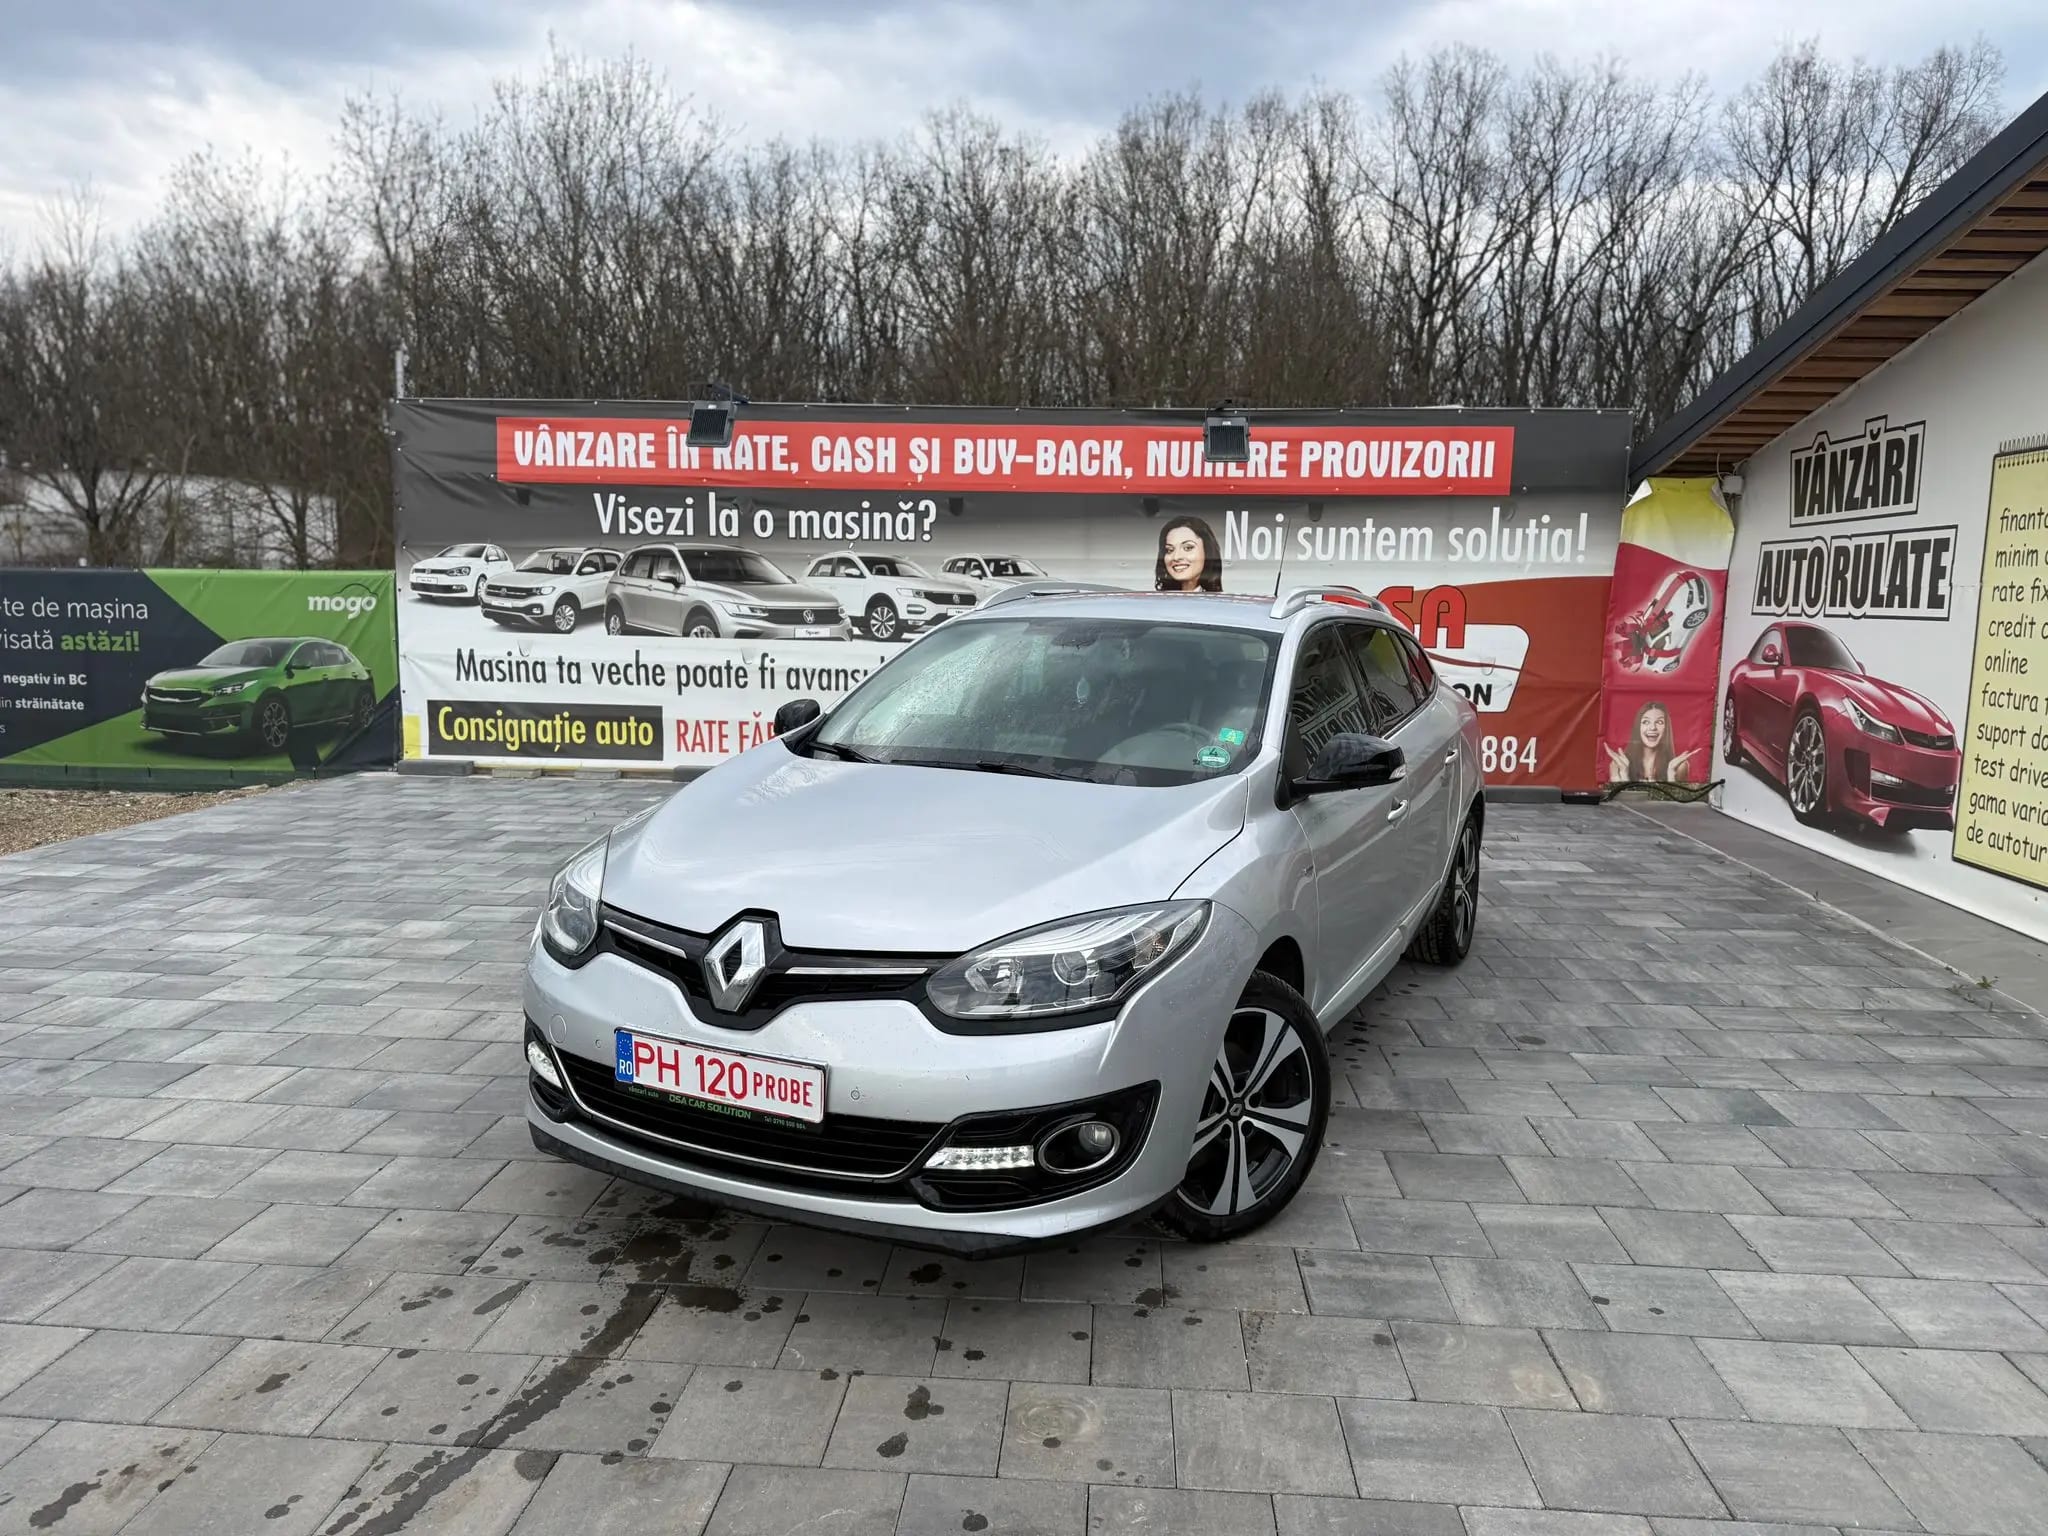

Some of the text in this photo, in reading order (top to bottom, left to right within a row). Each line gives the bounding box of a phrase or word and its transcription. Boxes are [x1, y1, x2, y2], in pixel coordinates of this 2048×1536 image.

[514, 424, 656, 468] VÂNZARE
[811, 435, 896, 473] CASH
[909, 437, 941, 483] ȘI
[1300, 440, 1496, 479] PROVIZORII
[1794, 427, 1919, 518] VÂNZĂRI
[593, 491, 938, 549] Visezi la o mașină?
[1224, 506, 1588, 575] Noi suntem soluția!
[1995, 543, 2039, 568] minim
[1756, 537, 1951, 610] AUTO RULATE
[1992, 581, 2025, 603] rate
[32, 596, 59, 617] de
[67, 598, 149, 624] mașina
[307, 595, 377, 620] mogo
[1988, 613, 2036, 640] credit
[61, 630, 140, 652] astăzi!
[556, 655, 582, 685] ta
[592, 649, 666, 686] veche
[676, 660, 749, 696] poate
[759, 653, 775, 690] fi
[1984, 648, 2029, 675] online
[3, 673, 51, 687] negativ
[69, 673, 88, 686] BC
[15, 697, 85, 711] străinătate
[1982, 682, 2039, 713] factura
[438, 706, 655, 753] Consignație auto
[676, 719, 730, 754] RATE
[1977, 723, 2027, 750] suport
[1974, 753, 2006, 780] test
[1969, 792, 2007, 817] gama
[1966, 819, 1985, 844] de
[619, 1059, 633, 1076] RO
[633, 1040, 814, 1108] PH 120 PROBE
[688, 1098, 706, 1110] CAR
[707, 1103, 752, 1120] SOLUTION
